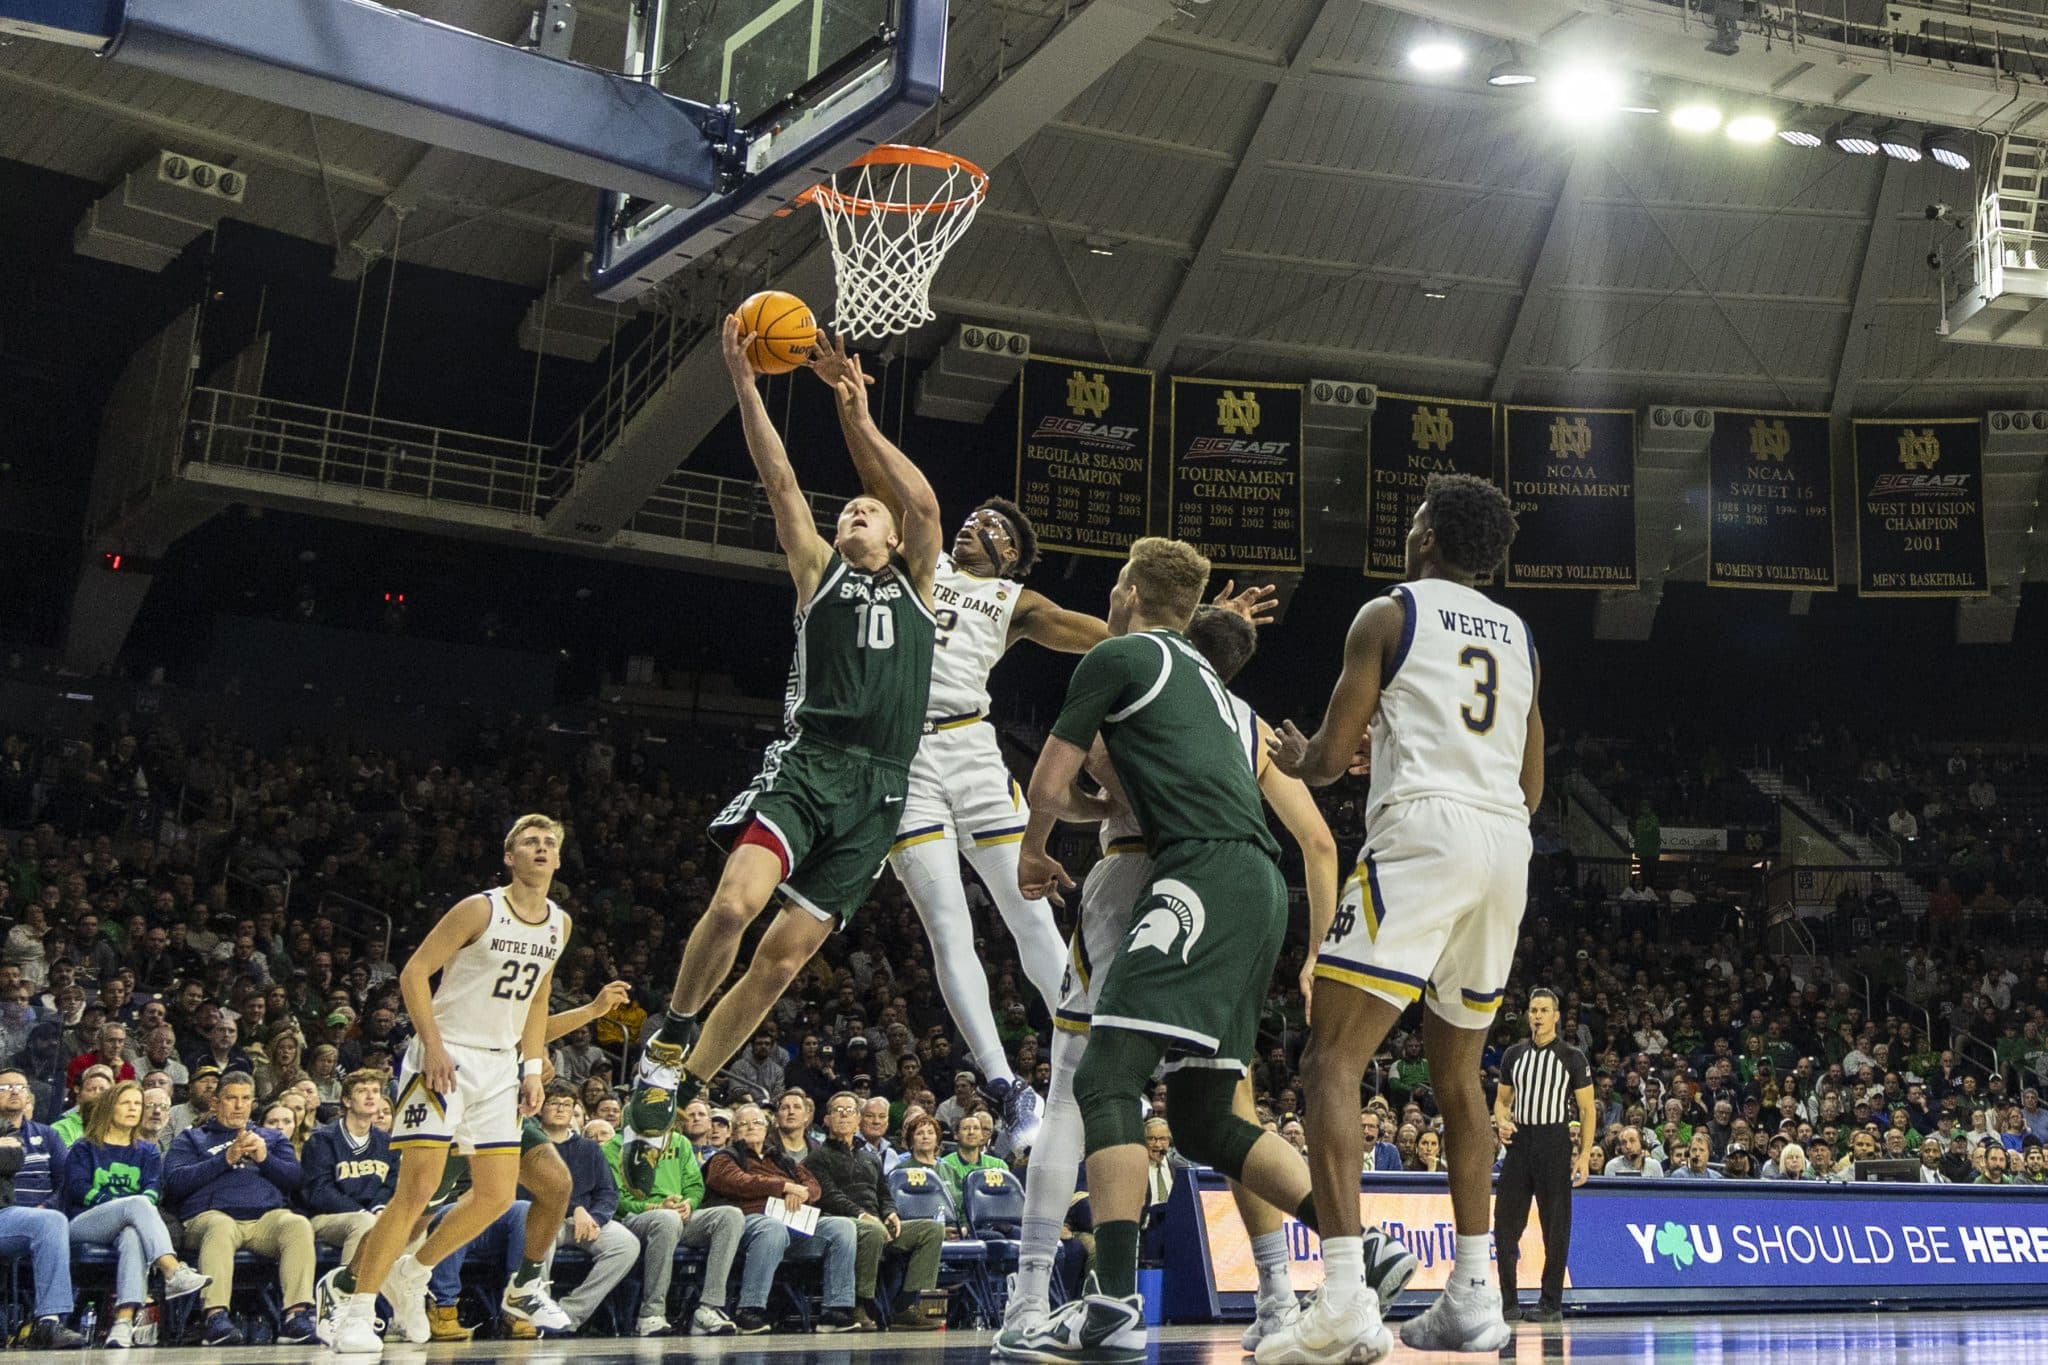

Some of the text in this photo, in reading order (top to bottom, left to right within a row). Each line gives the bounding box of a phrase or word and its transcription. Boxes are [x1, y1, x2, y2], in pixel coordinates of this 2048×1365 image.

[1027, 445, 1143, 472] REGULAR SEASON
[1408, 455, 1456, 472] NCAA
[1048, 464, 1121, 486] CHAMPION
[1178, 466, 1296, 486] TOURNAMENT
[1375, 469, 1428, 487] TOURN
[1547, 465, 1597, 479] NCAA
[1748, 467, 1795, 481] NCAA
[1026, 482, 1049, 493] 1995
[1193, 484, 1282, 500] CHAMPION
[1513, 481, 1630, 497] TOURNAMENT
[1730, 482, 1789, 499] SWEET
[1025, 493, 1050, 505] 2000
[1057, 497, 1079, 509] 2001
[1088, 501, 1111, 514] 2002
[1179, 502, 1295, 518] 1995 1996 1997 199
[1515, 502, 1538, 512] 2020
[1868, 502, 1976, 515] WEST DIVISION
[1056, 509, 1079, 521] 2005
[1088, 514, 1111, 526] 2009
[1178, 514, 1202, 526] 2000
[1209, 516, 1233, 527] 2001
[1241, 518, 1264, 529] 2002
[1885, 517, 1959, 531] CHAMPION
[1031, 522, 1073, 541] OMEN'S
[1178, 526, 1201, 538] 2005
[1190, 543, 1297, 561] MEN'S VOLLEYBALL
[1904, 537, 1941, 551] 2001
[1371, 552, 1406, 569] WOME
[1514, 564, 1632, 579] WOMEN'S VOLLEYBALL
[1716, 562, 1829, 581] WOMEN'S VOLLEYBALL
[1873, 573, 1975, 587] MEN'S BASKETBALL
[933, 583, 1003, 622] TRE DAME
[855, 604, 895, 649] 10
[1438, 608, 1512, 645] WERTZ
[1458, 644, 1500, 736] 3
[490, 938, 557, 960] NOTRE DAME
[492, 960, 541, 1001] 23
[1732, 1224, 1895, 1264] SHOULD
[1902, 1226, 1956, 1264] BE
[1958, 1226, 2048, 1264] HERE
